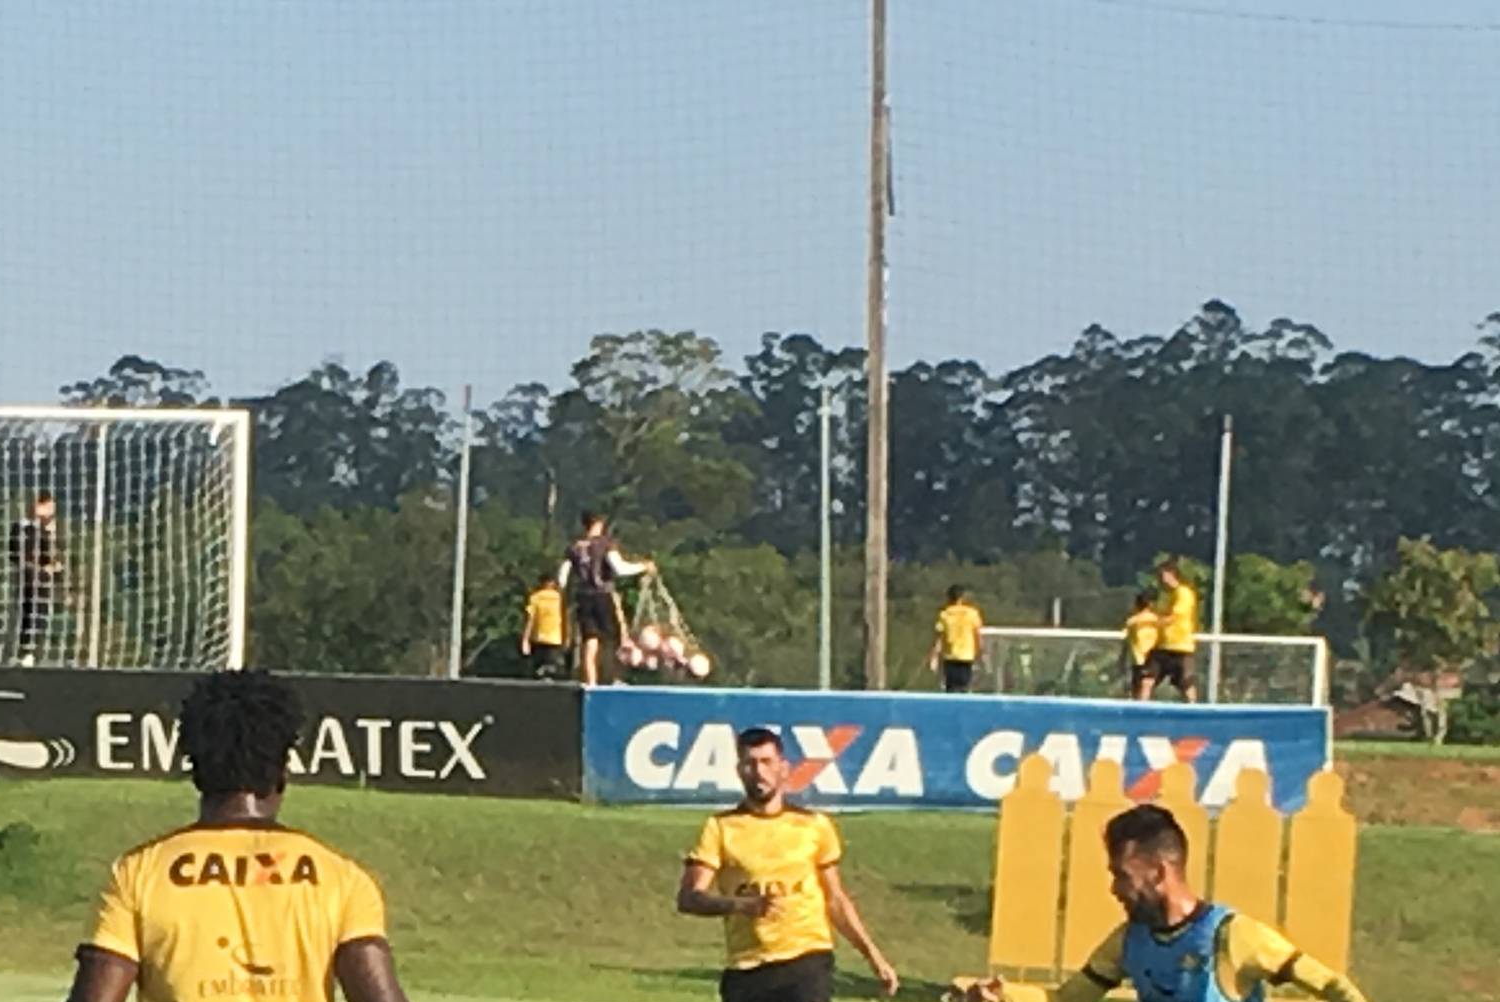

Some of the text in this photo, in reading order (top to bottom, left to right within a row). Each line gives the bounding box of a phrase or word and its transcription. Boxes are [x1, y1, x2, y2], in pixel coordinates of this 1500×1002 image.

[97, 712, 487, 780] EMATEX
[624, 720, 925, 797] CAXA
[169, 853, 319, 887] CAIXA
